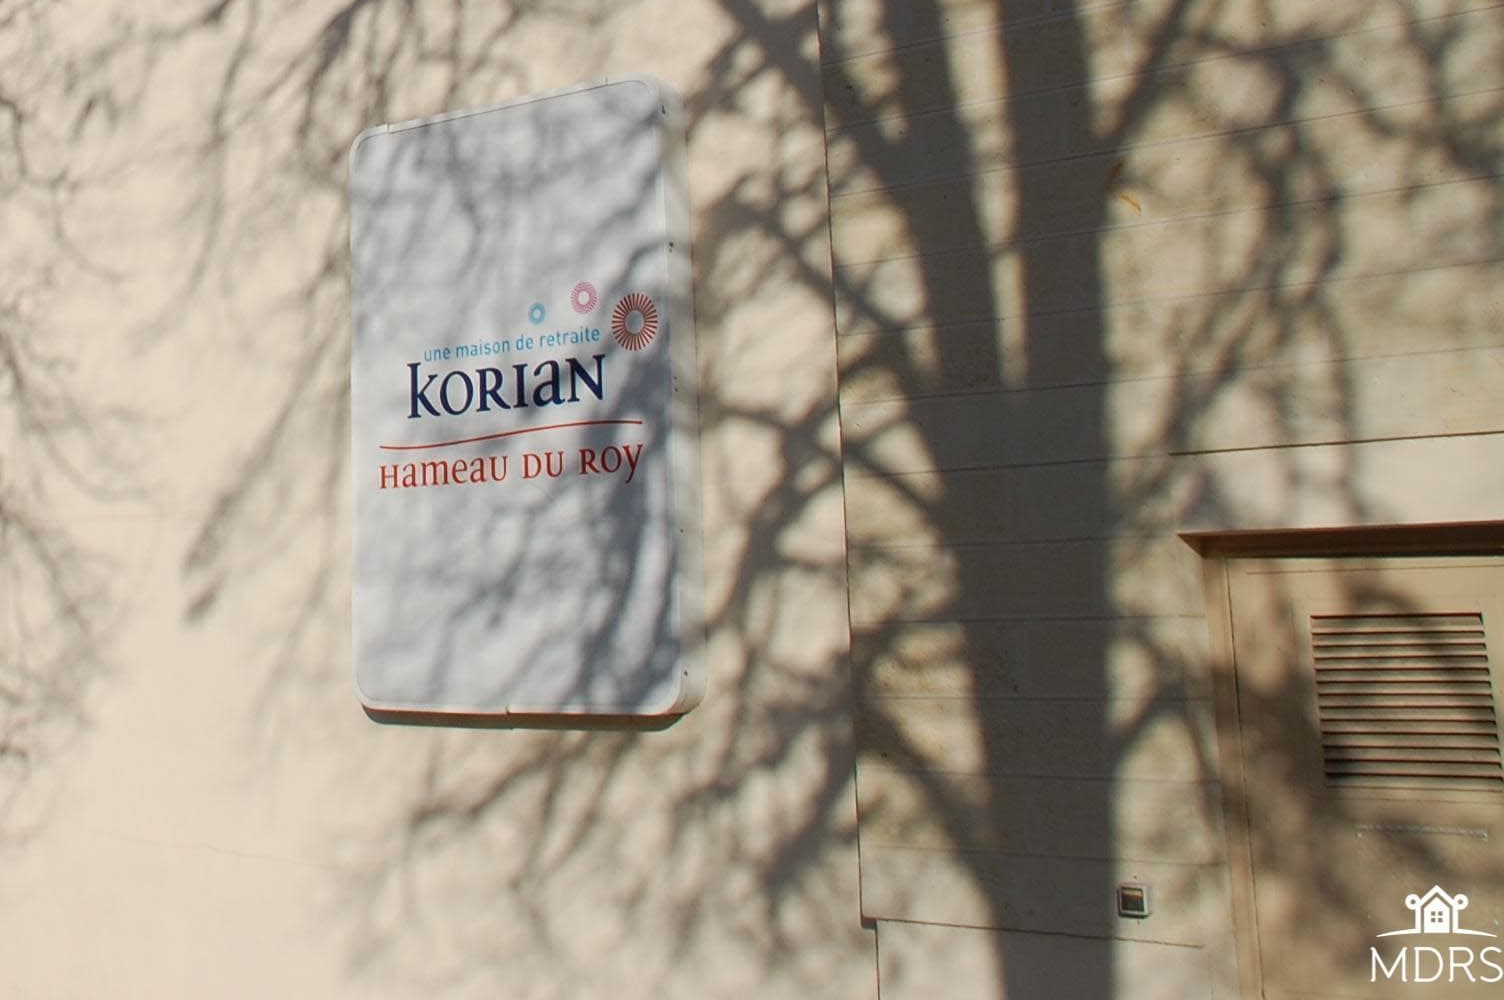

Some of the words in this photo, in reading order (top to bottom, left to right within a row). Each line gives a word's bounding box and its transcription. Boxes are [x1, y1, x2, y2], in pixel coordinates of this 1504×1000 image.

[424, 346, 452, 362] une
[456, 339, 511, 359] maison
[515, 334, 534, 351] de
[539, 325, 601, 348] retraite
[522, 450, 564, 480] DU
